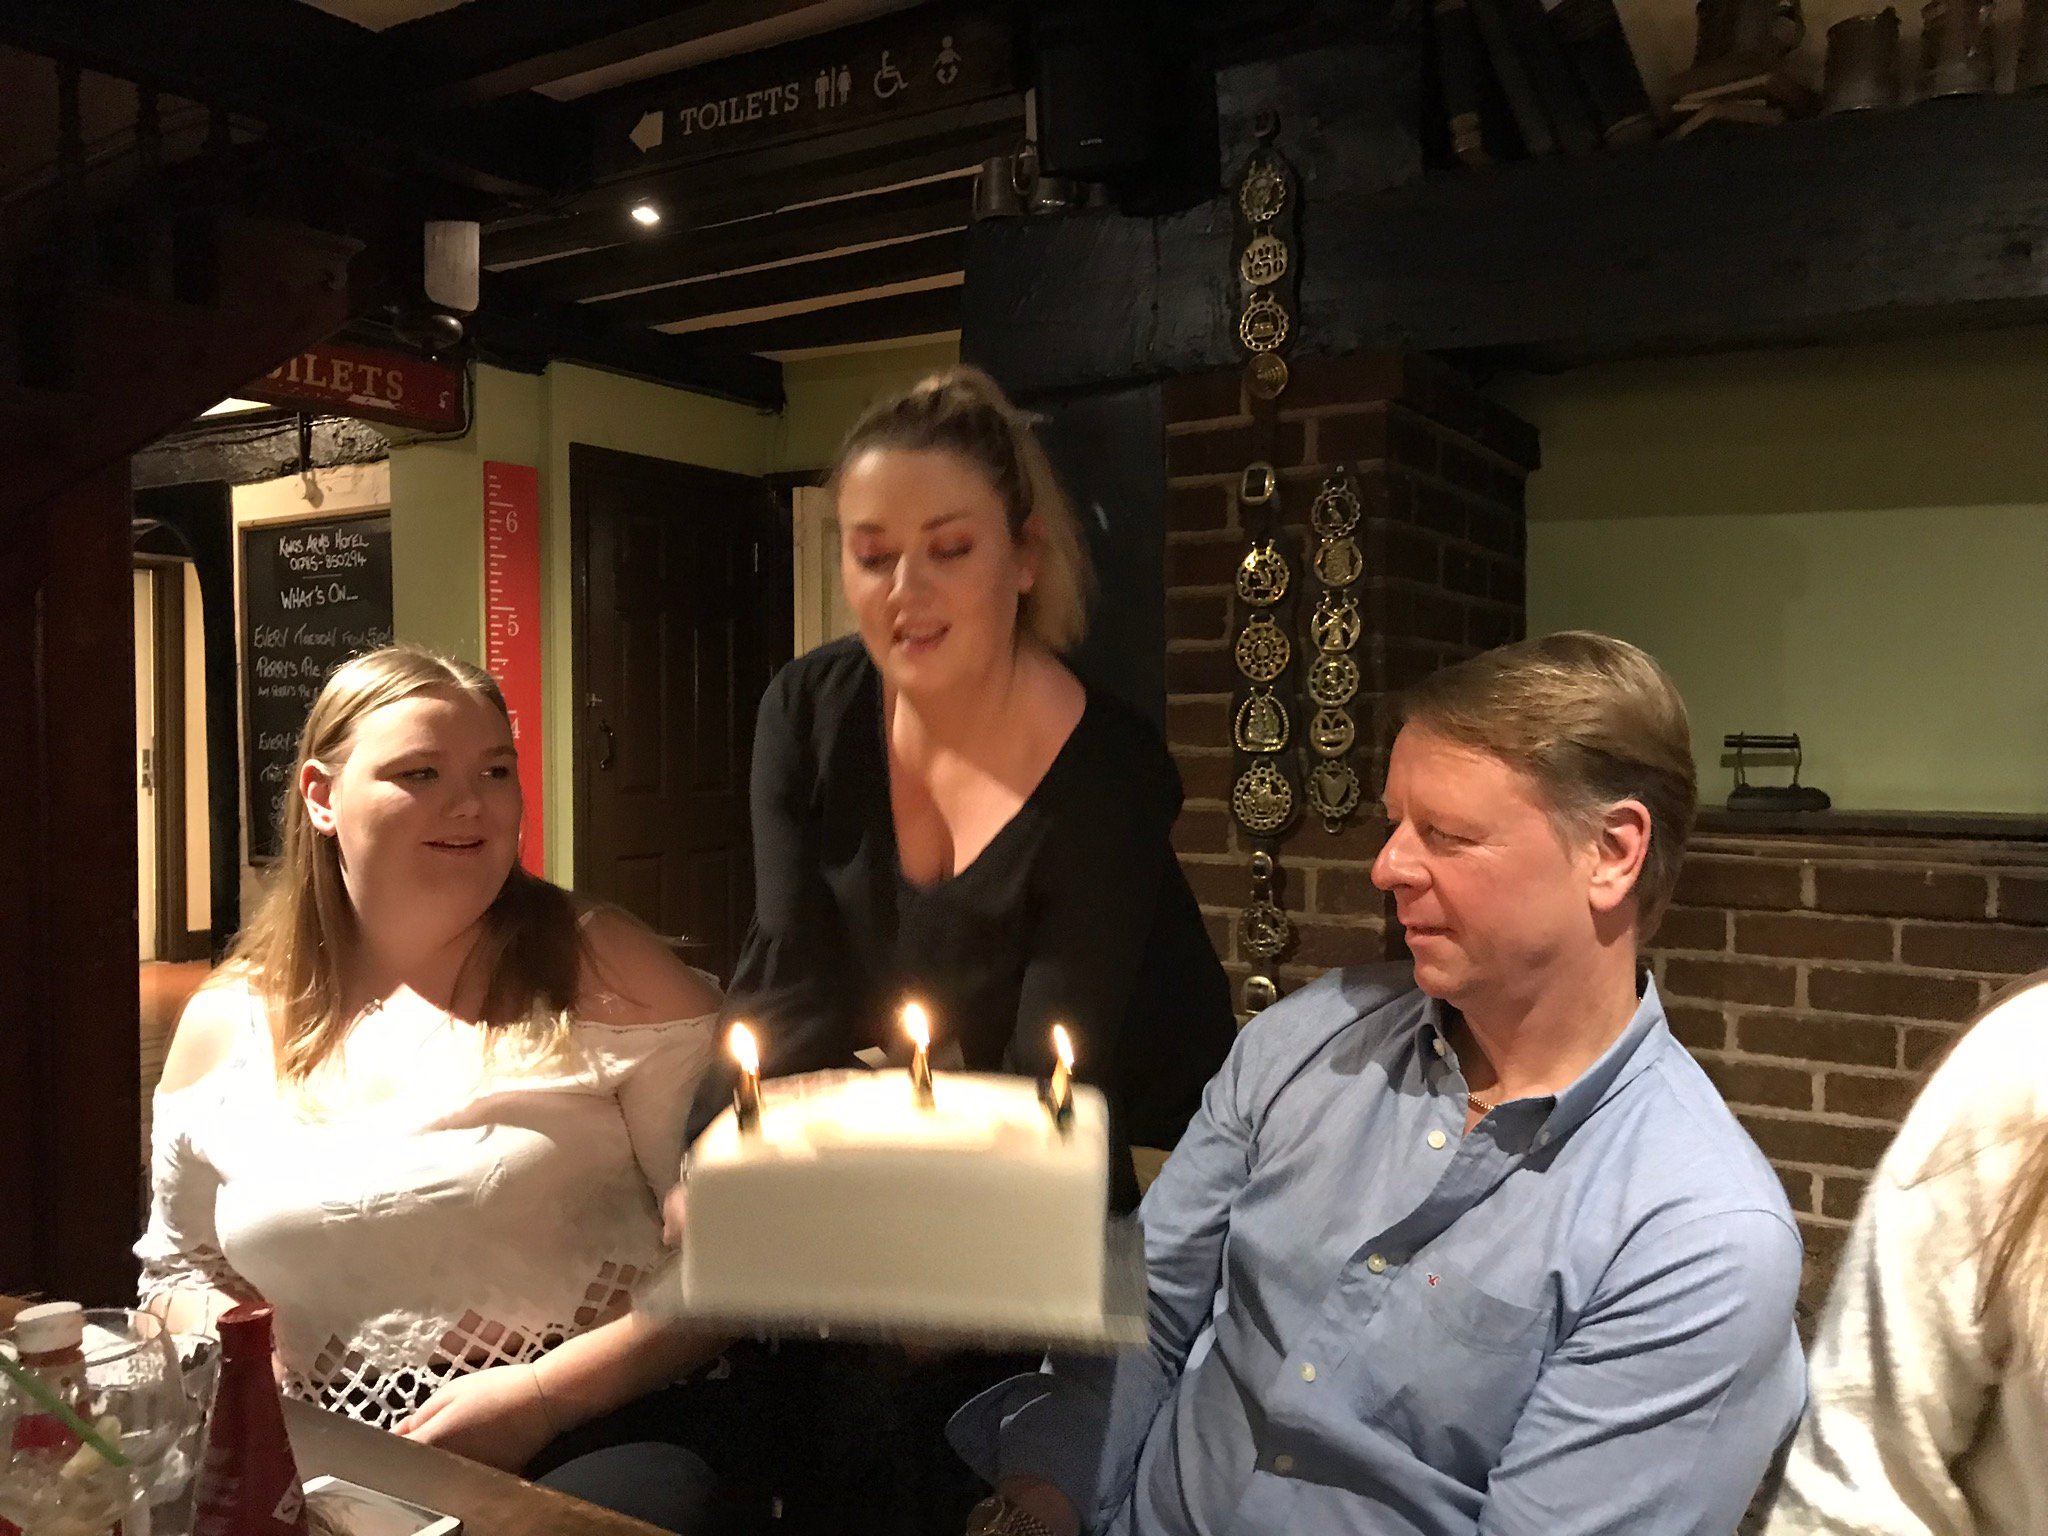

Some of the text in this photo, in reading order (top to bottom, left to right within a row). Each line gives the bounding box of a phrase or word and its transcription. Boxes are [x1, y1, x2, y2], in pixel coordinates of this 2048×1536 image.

[680, 82, 799, 136] TOILETS
[267, 353, 403, 400] ILETS
[506, 511, 518, 533] 6
[335, 528, 369, 550] HOTEL
[281, 585, 325, 609] WHAT'S
[507, 614, 519, 636] 5
[510, 717, 521, 739] 4
